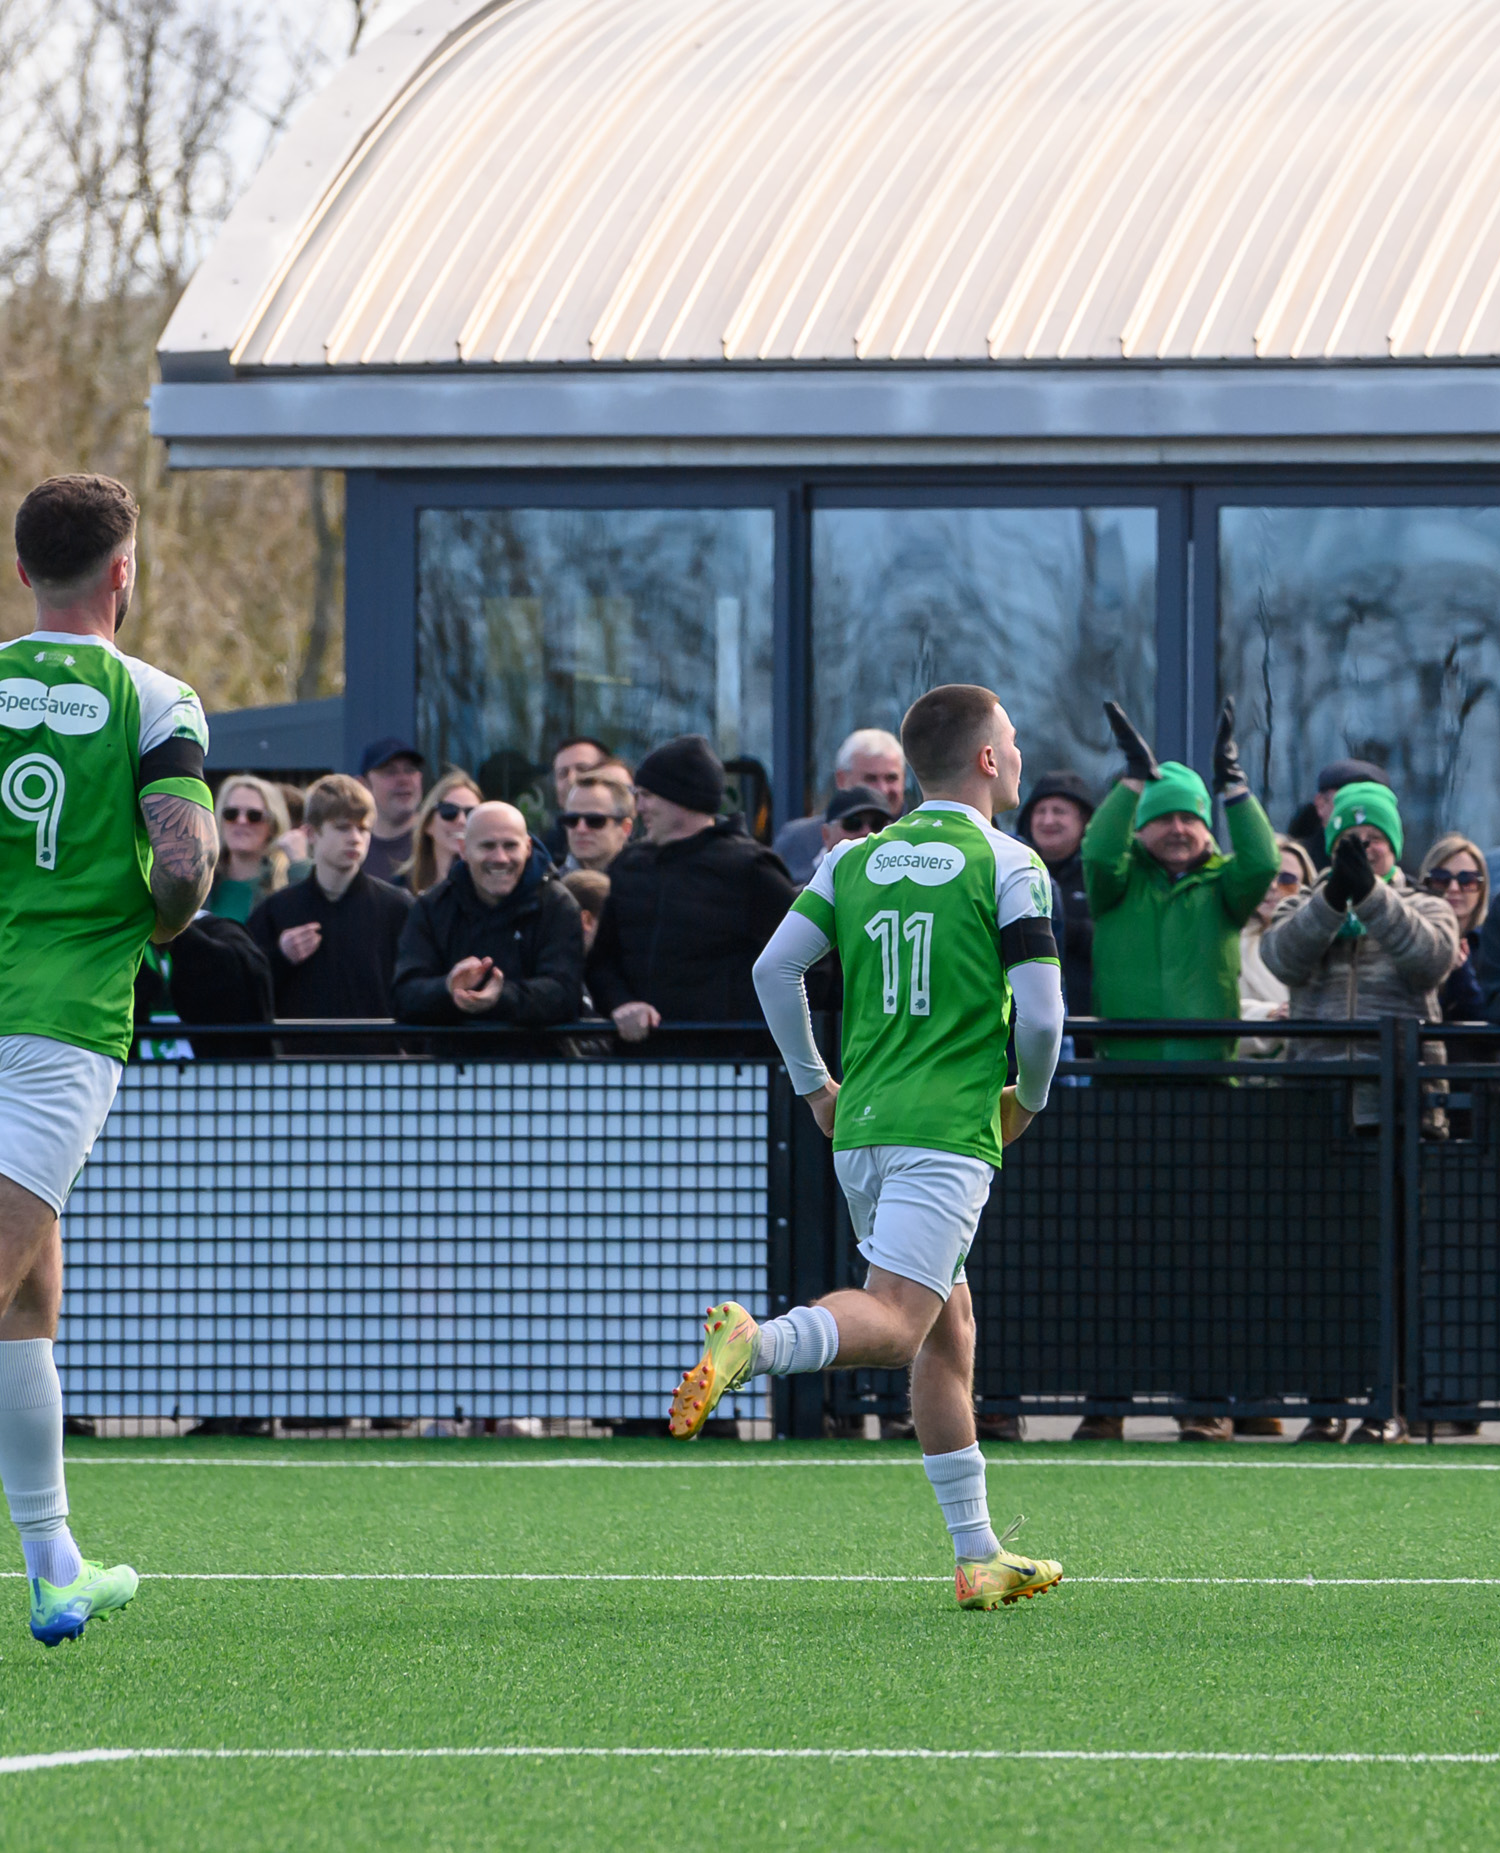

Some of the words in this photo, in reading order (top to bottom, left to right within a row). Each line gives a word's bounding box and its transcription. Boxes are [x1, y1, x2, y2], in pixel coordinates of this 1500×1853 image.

[0, 691, 99, 719] Specsavers
[1, 752, 66, 870] 9
[874, 853, 954, 872] Specsavers
[864, 910, 934, 1016] 11
